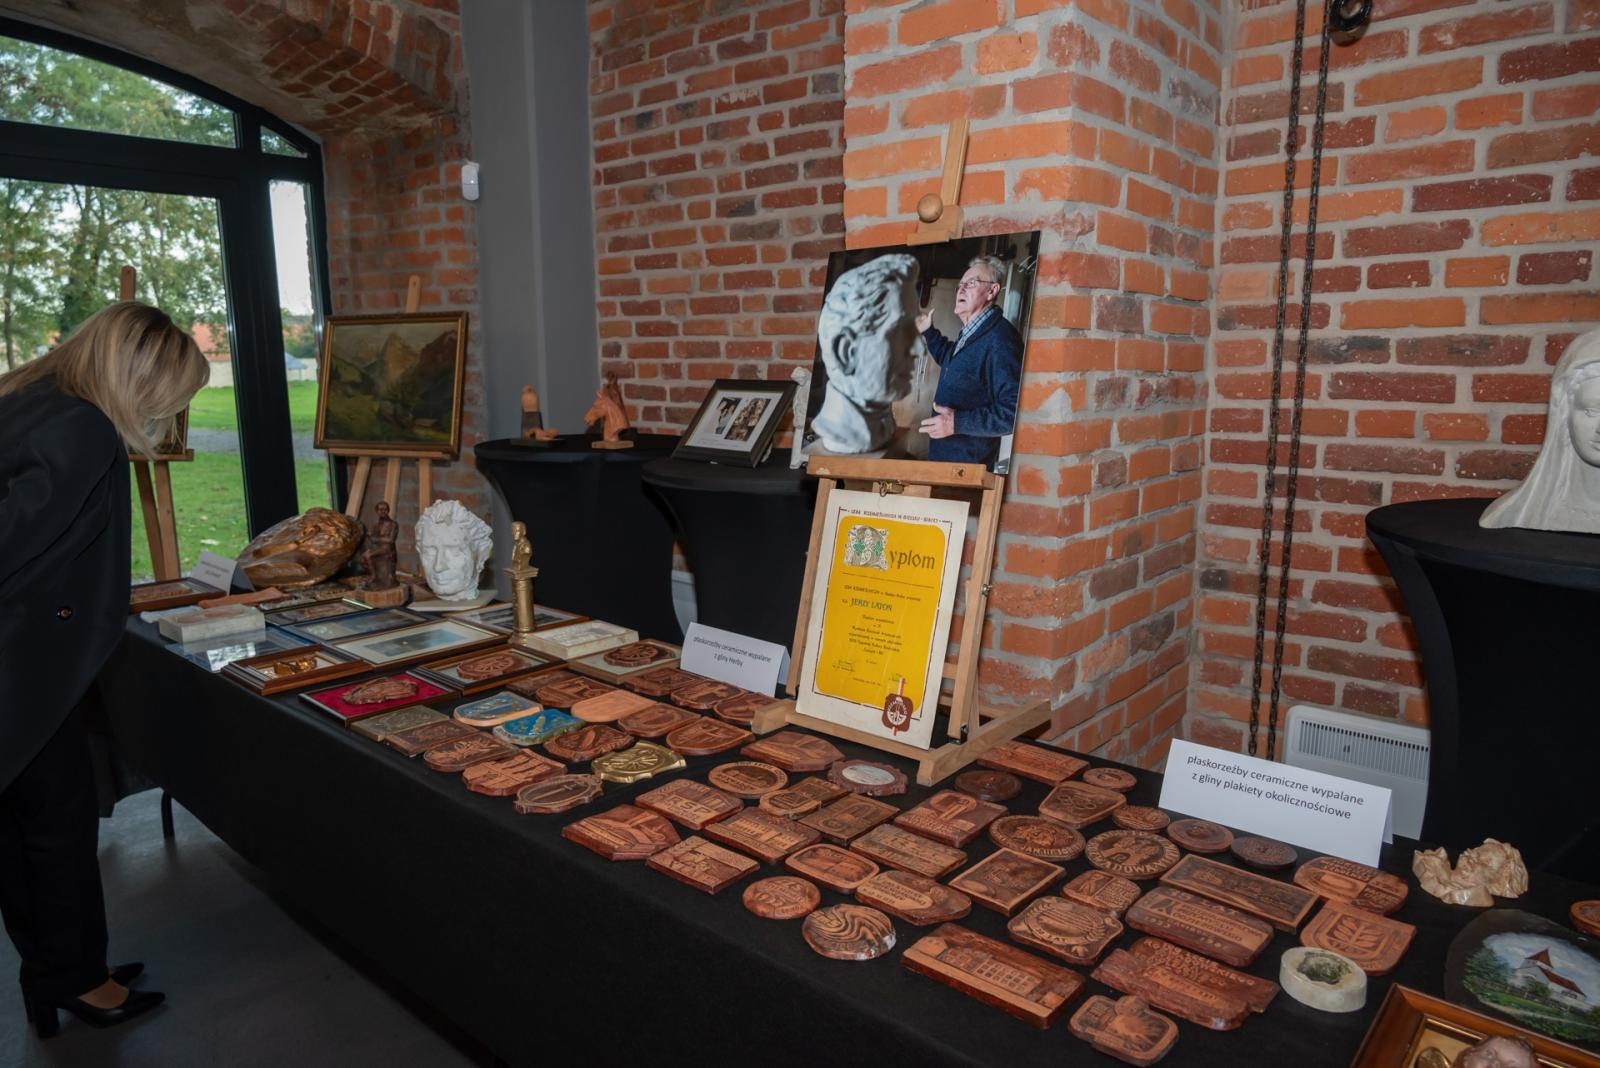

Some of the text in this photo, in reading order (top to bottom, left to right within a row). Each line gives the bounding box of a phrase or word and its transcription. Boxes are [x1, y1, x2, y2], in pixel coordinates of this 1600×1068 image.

[717, 653, 728, 663] gliny
[721, 644, 748, 656] ceramiczne
[748, 652, 771, 664] wypalane
[1187, 754, 1365, 806] płaskorzeźby ceramiczne wypalane
[1191, 772, 1352, 820] z gliny plakiety okolicznościowe
